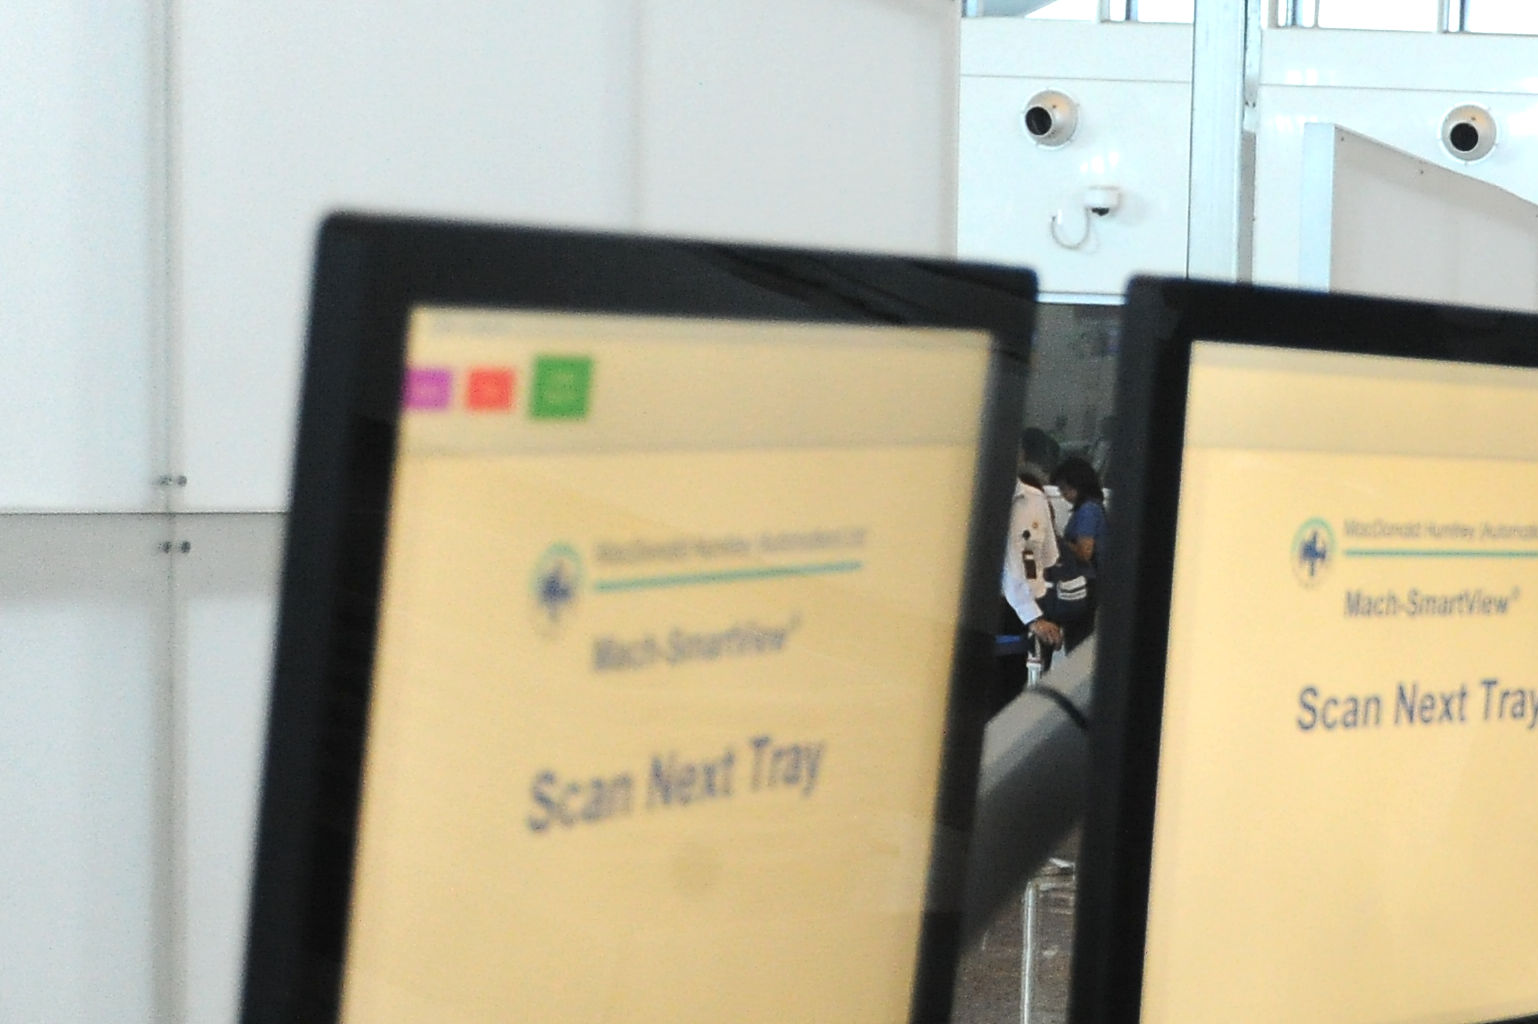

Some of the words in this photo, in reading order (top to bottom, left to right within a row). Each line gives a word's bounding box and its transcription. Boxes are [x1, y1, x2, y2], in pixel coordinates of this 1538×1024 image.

[1297, 685, 1382, 731] Scan
[1394, 682, 1468, 726] Next
[527, 768, 634, 833] Scan
[646, 749, 736, 811] Next
[748, 733, 826, 799] Tray
